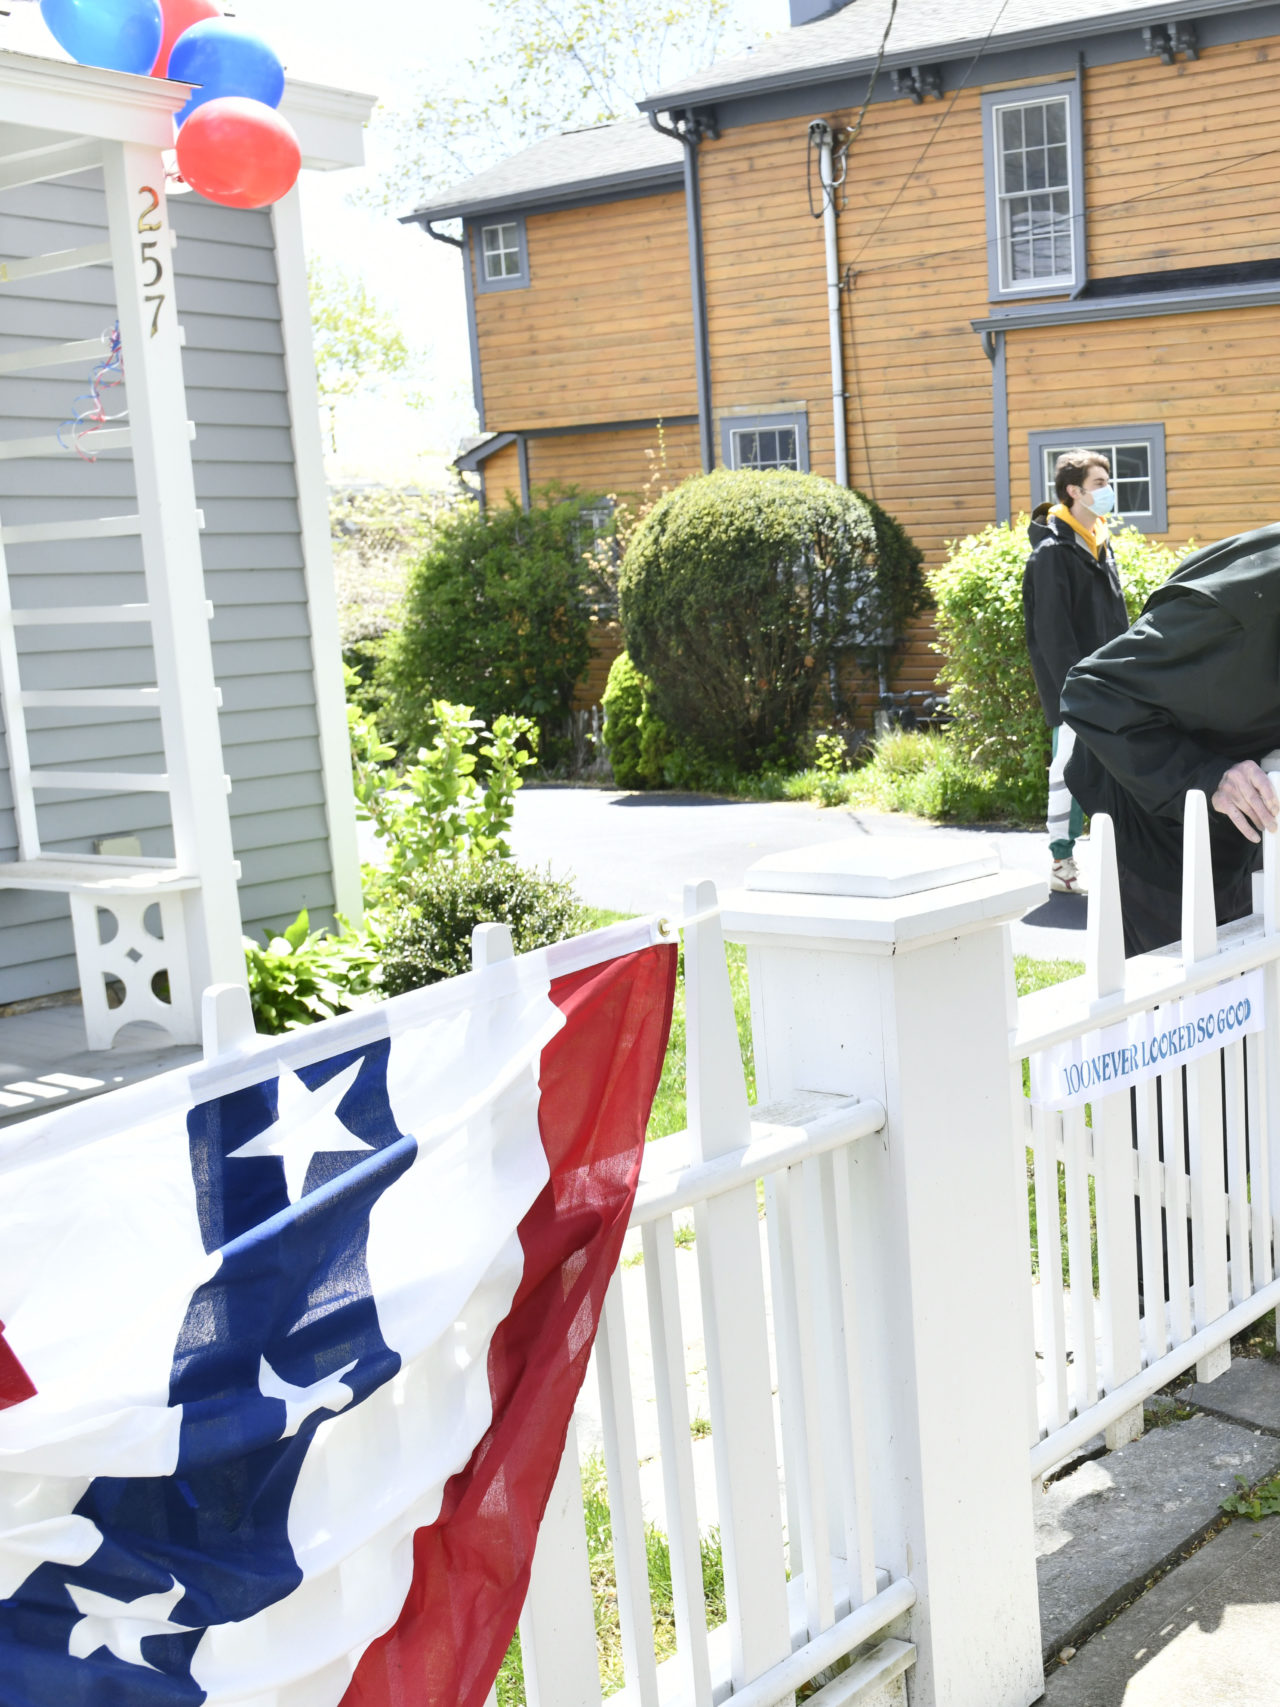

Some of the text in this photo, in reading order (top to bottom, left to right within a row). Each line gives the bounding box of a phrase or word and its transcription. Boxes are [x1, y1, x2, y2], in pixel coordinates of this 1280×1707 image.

[137, 186, 166, 338] 257
[1063, 997, 1252, 1096] 100 NEVER LOOKED SO GOOD
